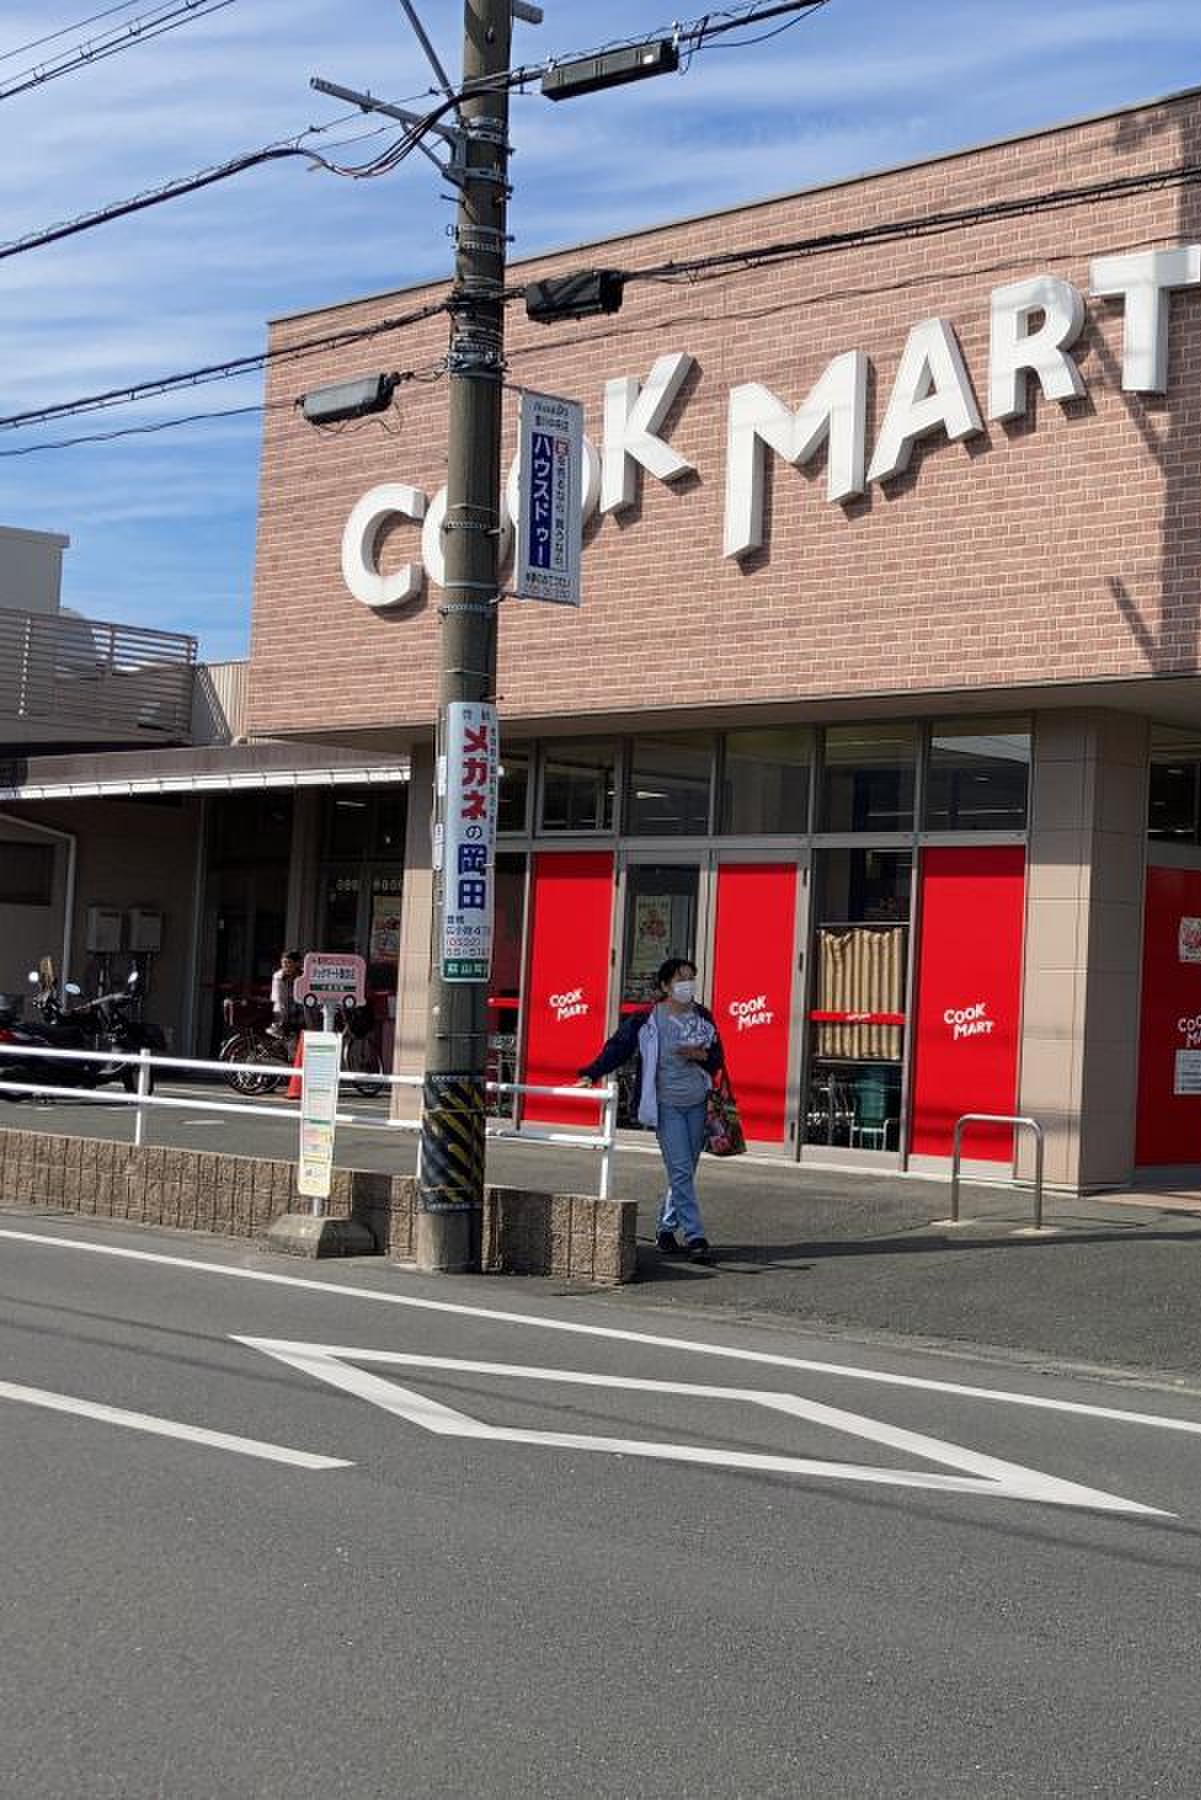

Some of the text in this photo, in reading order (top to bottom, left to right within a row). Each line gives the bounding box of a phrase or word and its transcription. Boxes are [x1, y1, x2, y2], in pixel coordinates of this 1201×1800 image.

[549, 988, 583, 1008] COOK
[729, 995, 768, 1016] COOK
[556, 1003, 590, 1021] MART
[737, 1011, 775, 1031] MART
[943, 1002, 986, 1024] COOK
[953, 1020, 994, 1040] MART
